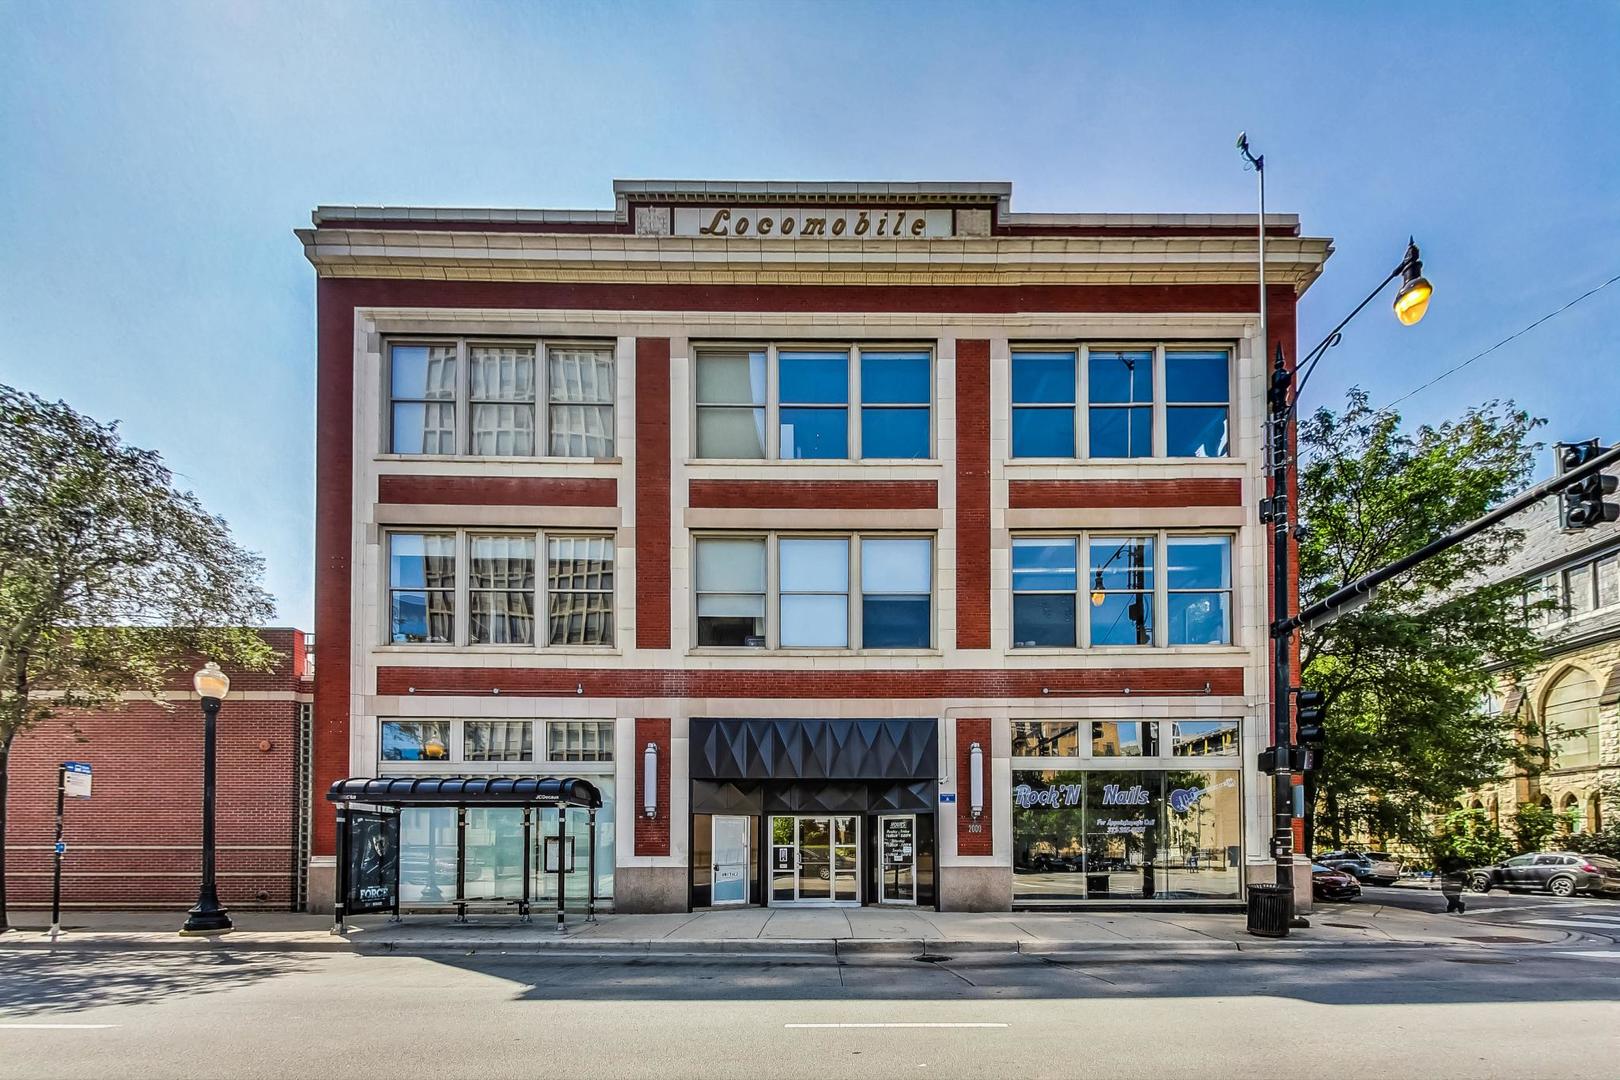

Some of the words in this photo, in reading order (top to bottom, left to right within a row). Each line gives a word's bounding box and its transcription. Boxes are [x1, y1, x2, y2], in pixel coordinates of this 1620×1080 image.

[700, 208, 927, 237] Locomobile
[1014, 784, 1081, 808] Rock'N
[1103, 784, 1150, 805] Nails
[968, 824, 982, 833] 2000
